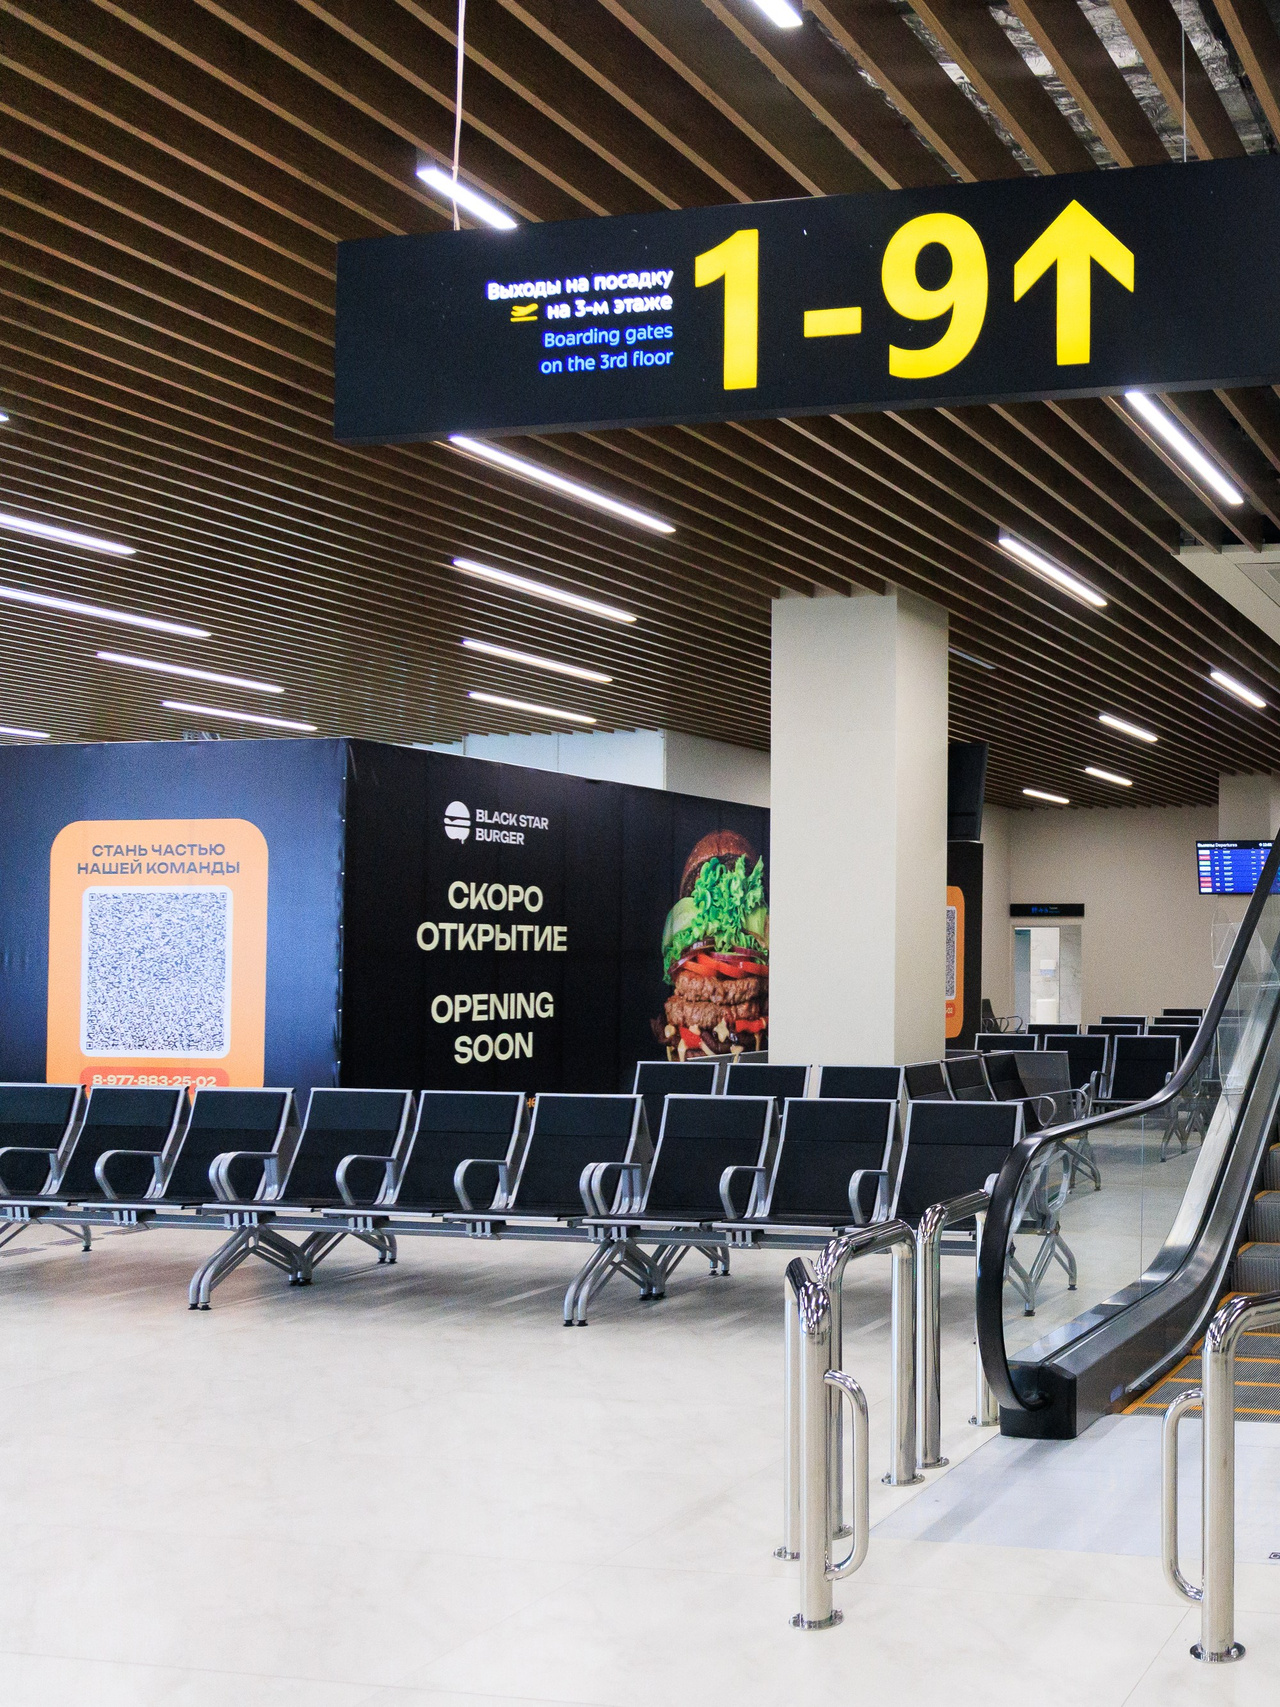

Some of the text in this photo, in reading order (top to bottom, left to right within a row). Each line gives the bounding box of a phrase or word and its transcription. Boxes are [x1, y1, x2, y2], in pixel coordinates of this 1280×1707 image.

[487, 269, 674, 300] Выходы на посадку
[546, 294, 673, 320] на 3-м этаже
[543, 323, 674, 348] Boarding gates
[540, 349, 674, 374] on the 3rd floor
[475, 809, 550, 830] BLACK STAR
[475, 828, 525, 845] BURGER
[91, 843, 226, 858] СТАНЬ ЧАСТЬЮ
[77, 859, 240, 876] НАШЕЙ КОМАНДЫ
[448, 881, 544, 913] СКОРО
[416, 921, 568, 952] ОТКРЫТИЕ
[430, 991, 555, 1024] OPENING
[453, 1032, 534, 1065] SOON
[92, 1074, 217, 1087] 8-977-883-25-02
